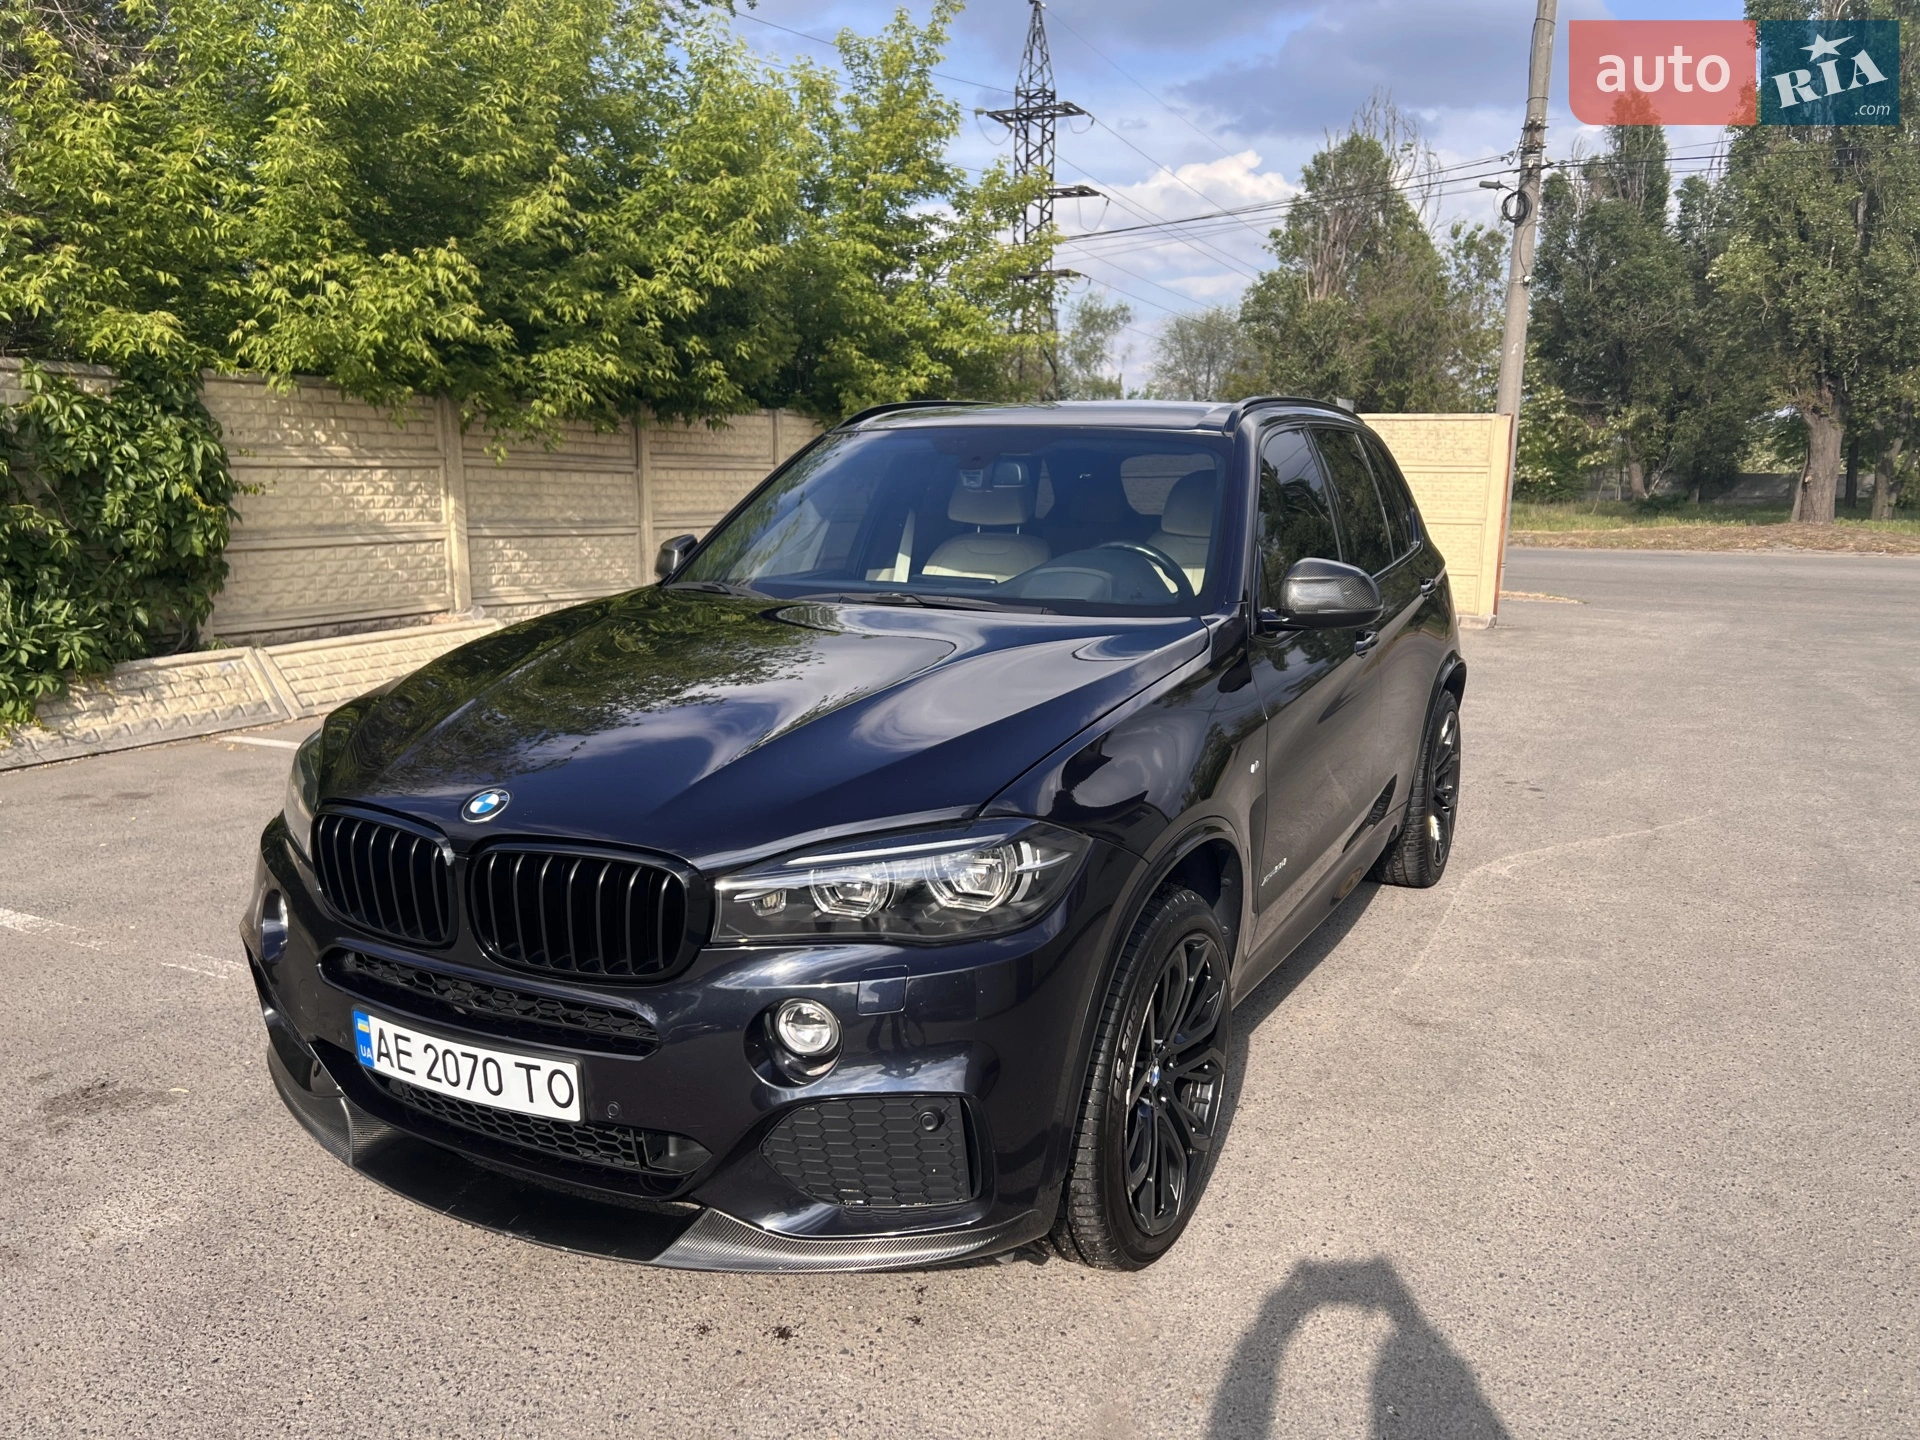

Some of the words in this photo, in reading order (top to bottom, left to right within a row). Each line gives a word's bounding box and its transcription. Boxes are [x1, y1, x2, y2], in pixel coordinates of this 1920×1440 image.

[360, 1044, 373, 1060] UA
[376, 1027, 416, 1076] AE
[423, 1043, 504, 1097] 2070
[514, 1061, 575, 1109] TO
